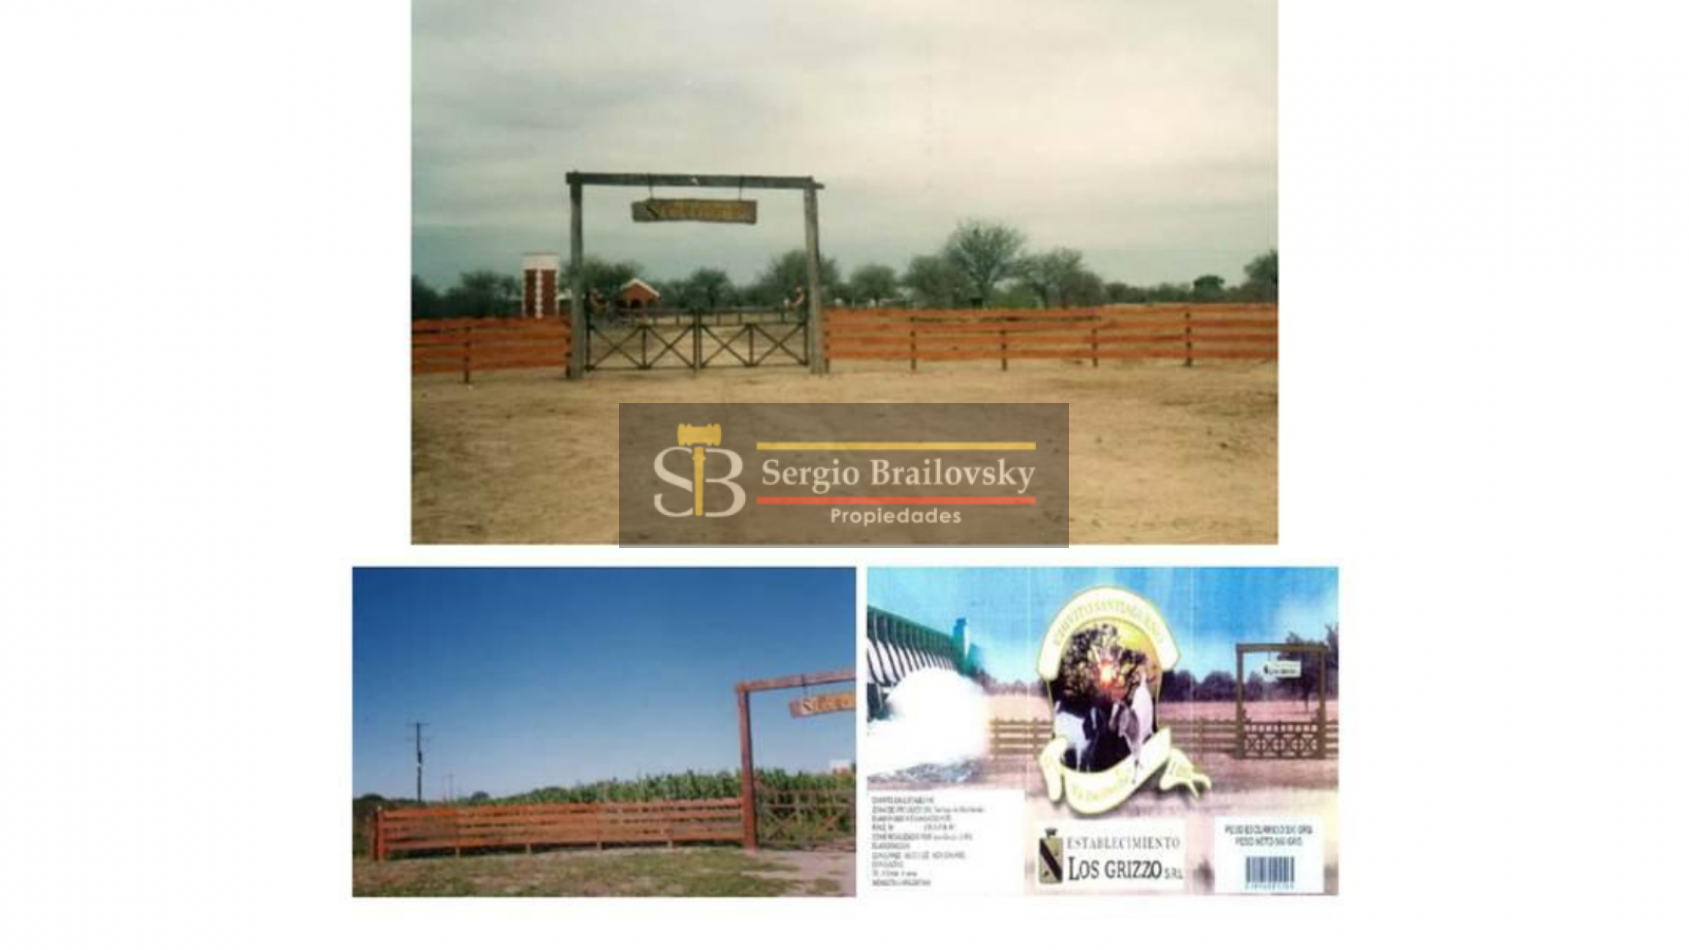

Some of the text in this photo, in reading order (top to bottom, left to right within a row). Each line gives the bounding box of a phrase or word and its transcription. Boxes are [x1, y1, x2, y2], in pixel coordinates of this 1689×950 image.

[1067, 835, 1181, 849] ESTABLECIMIENTO
[1068, 856, 1100, 881] LOS
[1104, 859, 1162, 879] GRIZZO
